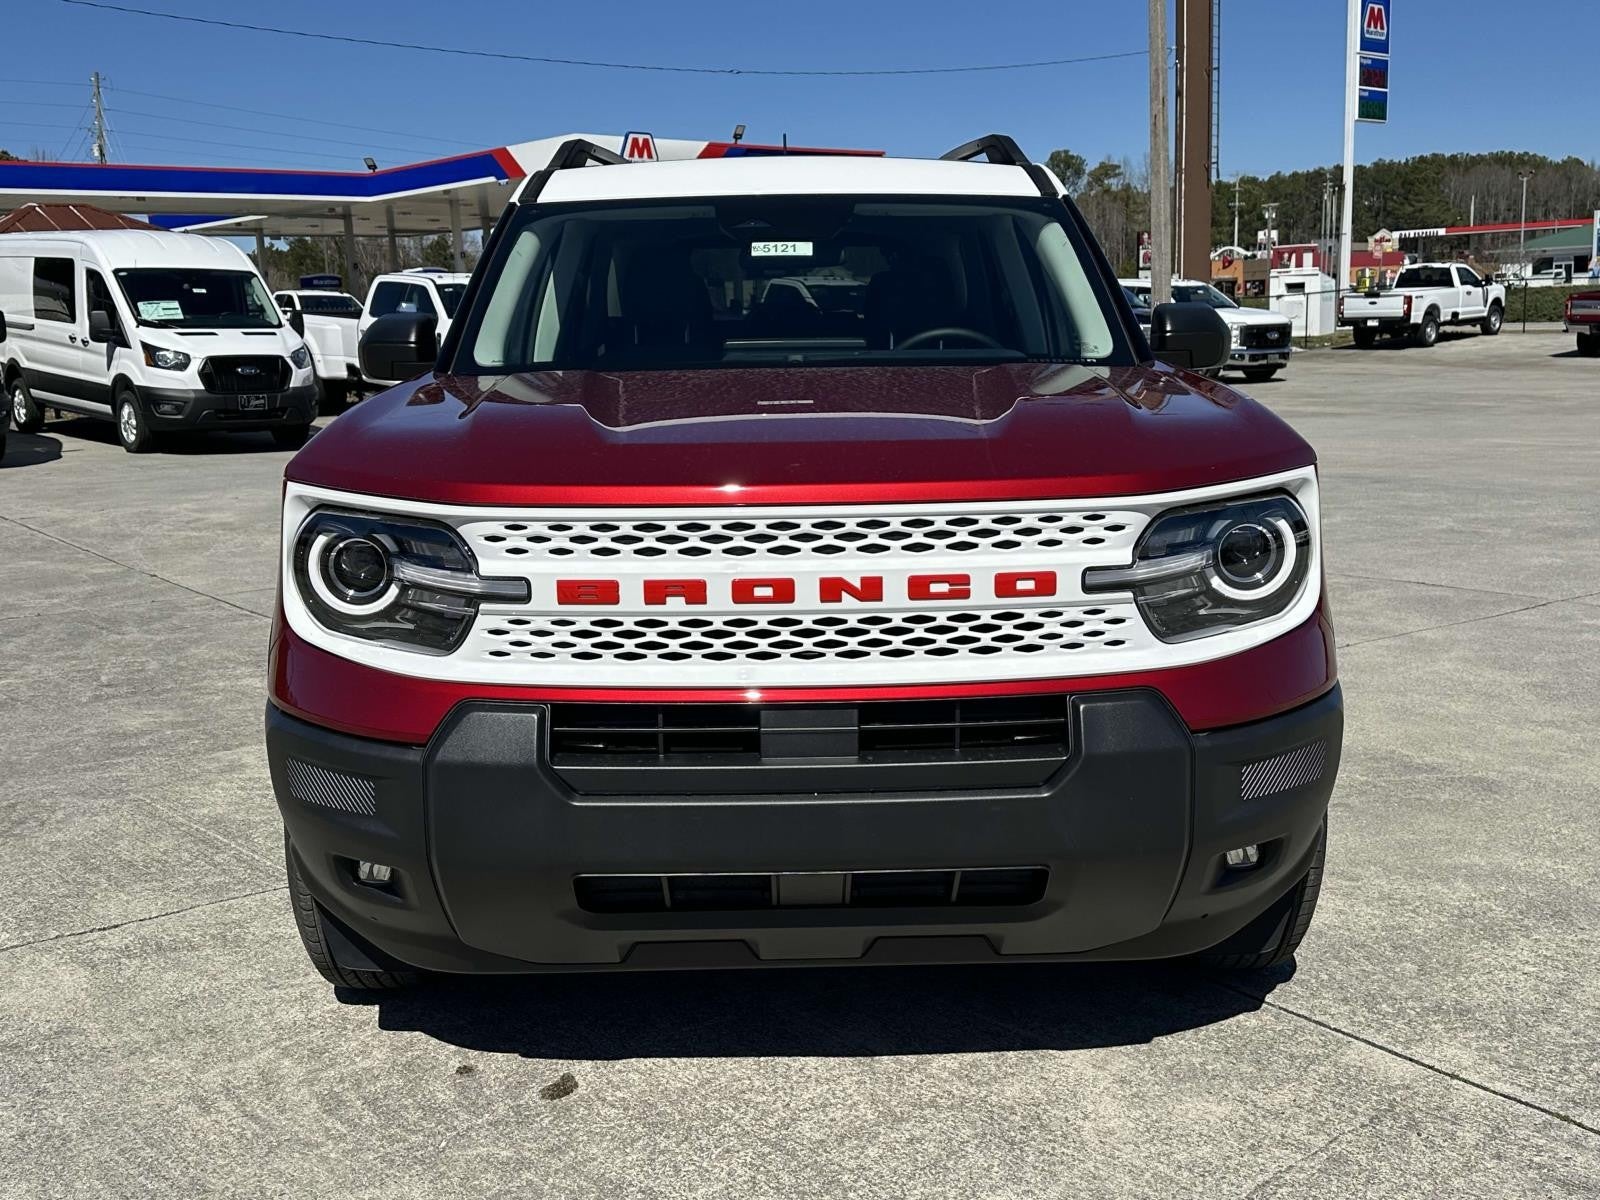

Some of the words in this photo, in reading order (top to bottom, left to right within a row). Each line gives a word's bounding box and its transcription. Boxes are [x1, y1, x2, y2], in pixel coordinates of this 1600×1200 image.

[1366, 6, 1385, 31] M
[628, 137, 653, 159] M
[763, 243, 797, 253] 5121
[556, 570, 1057, 606] BRONCO
